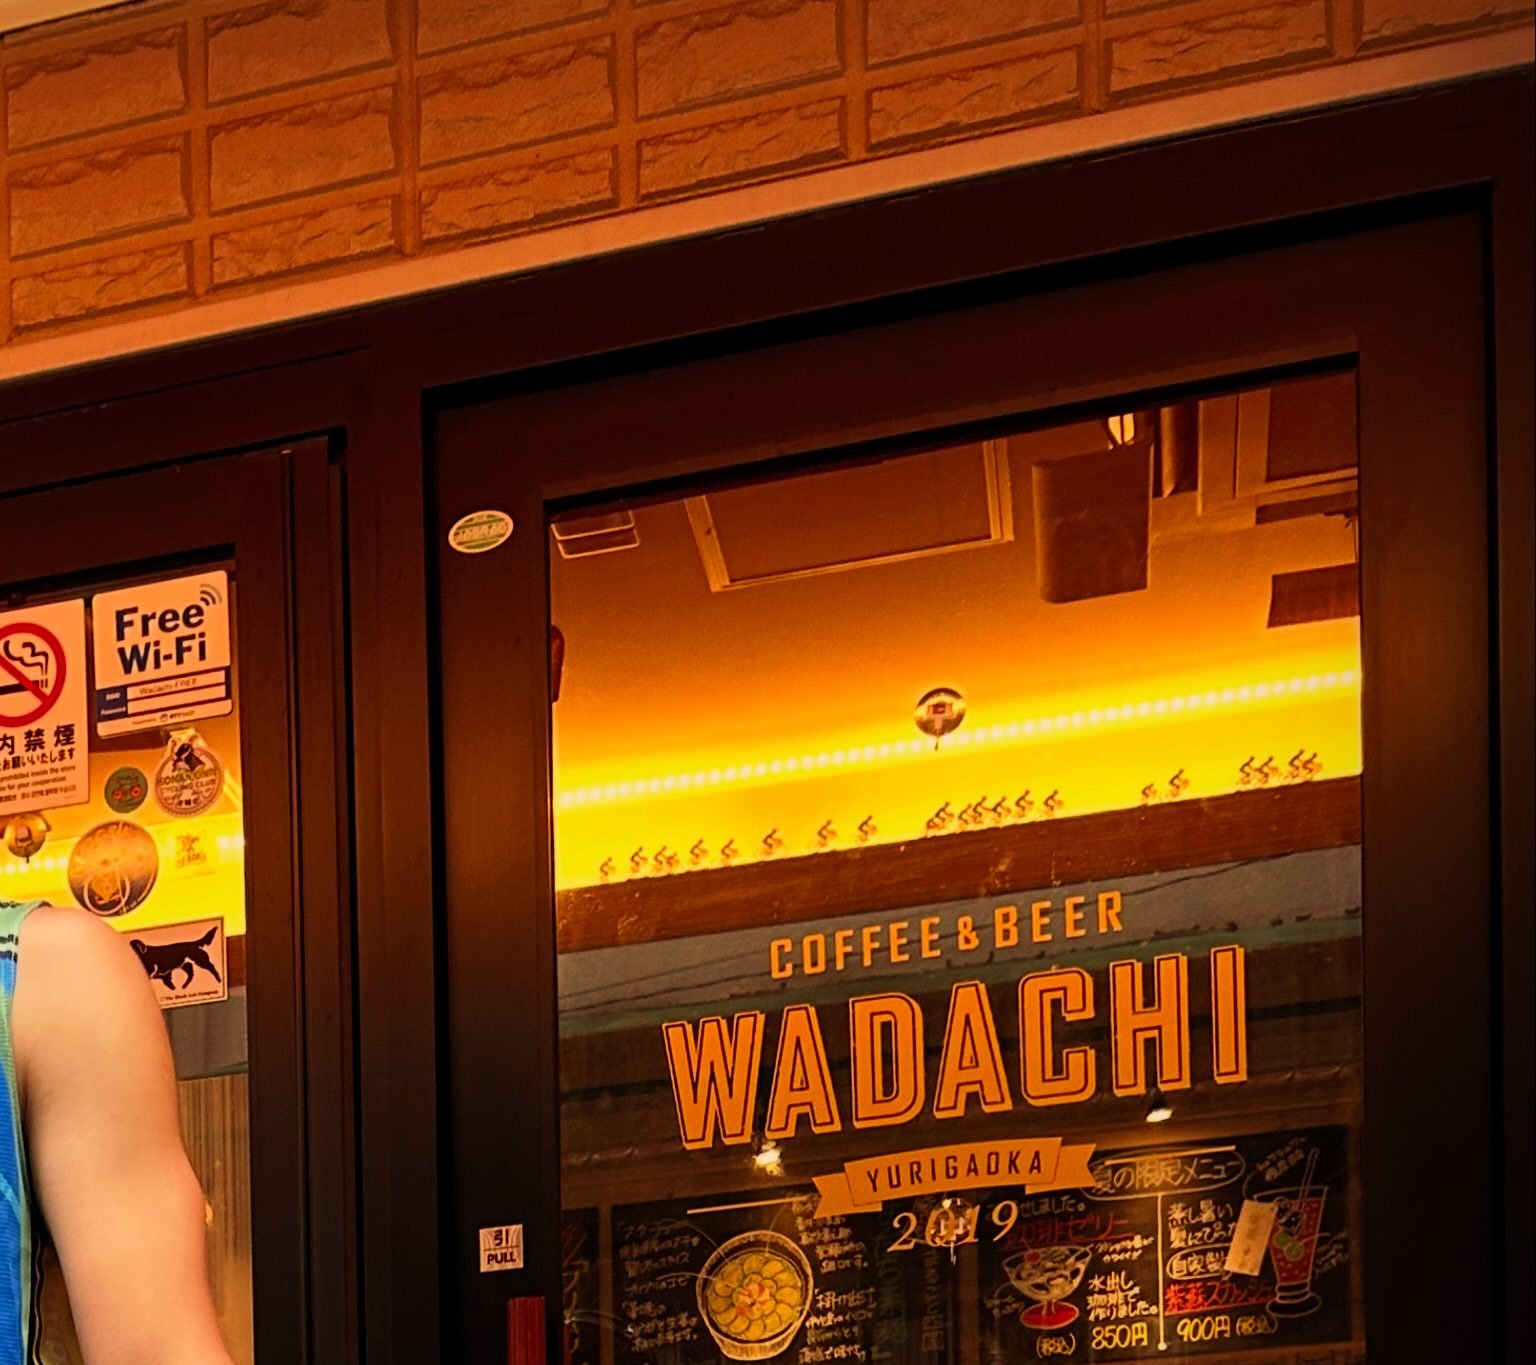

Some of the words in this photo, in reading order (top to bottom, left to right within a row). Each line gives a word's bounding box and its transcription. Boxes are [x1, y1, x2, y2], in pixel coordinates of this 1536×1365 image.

[115, 603, 205, 642] Free
[117, 632, 206, 675] Wi-Fi
[769, 915, 942, 980] COFFEE
[955, 915, 981, 951] &
[993, 890, 1124, 950] BEER
[662, 944, 1248, 1152] WADACHI
[866, 1150, 1042, 1193] YURIGAOKA
[493, 1228, 510, 1247] 引
[886, 1199, 1019, 1253] 2019
[487, 1250, 517, 1265] PULL
[1091, 1321, 1149, 1350] 850円
[1176, 1315, 1231, 1343] 900円
